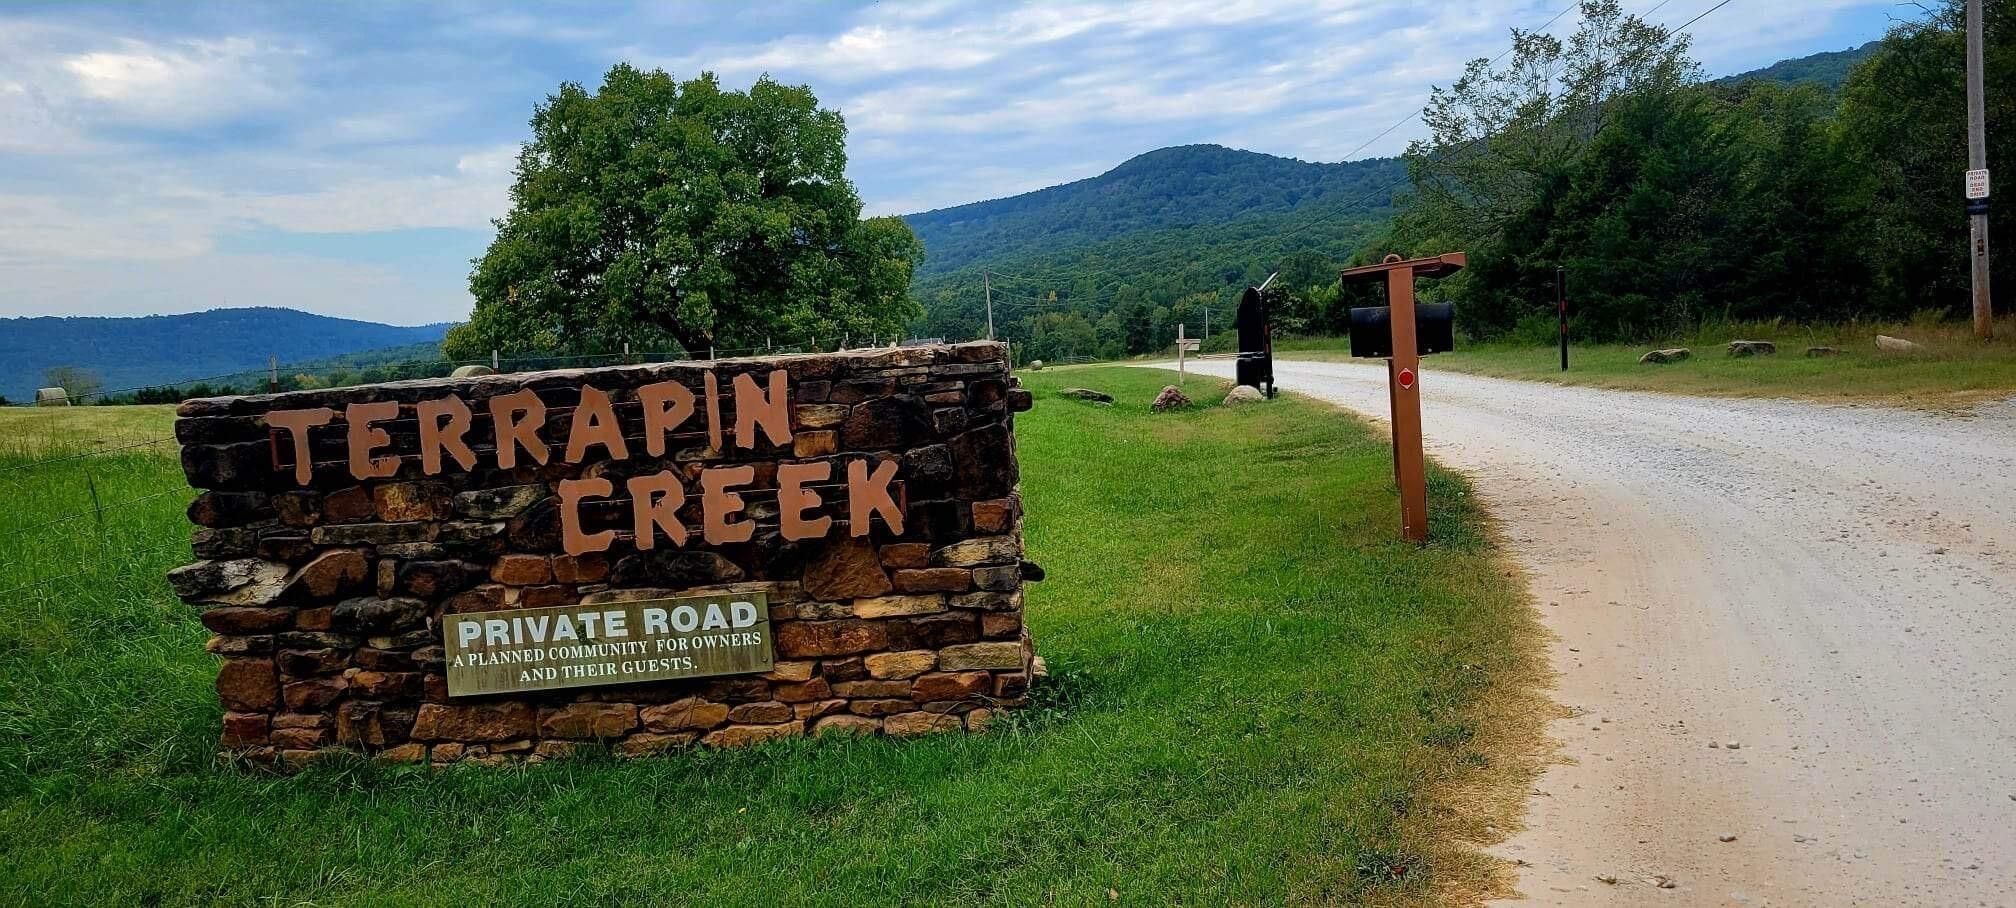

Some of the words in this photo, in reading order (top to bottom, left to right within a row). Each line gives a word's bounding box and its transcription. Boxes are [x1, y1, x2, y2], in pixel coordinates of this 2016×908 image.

[264, 369, 793, 486] TERRAPIN
[557, 459, 904, 557] CREEK
[458, 610, 629, 648] PRIVATE
[643, 601, 758, 635] ROAD
[453, 654, 464, 668] A
[468, 648, 545, 666] PLANNED
[549, 640, 648, 660] COMMUNITY
[656, 637, 689, 652] FOR
[692, 631, 762, 649] OWNERS
[519, 667, 557, 682] AND
[561, 662, 617, 679] THEIR
[622, 656, 698, 674] GUESTS.
